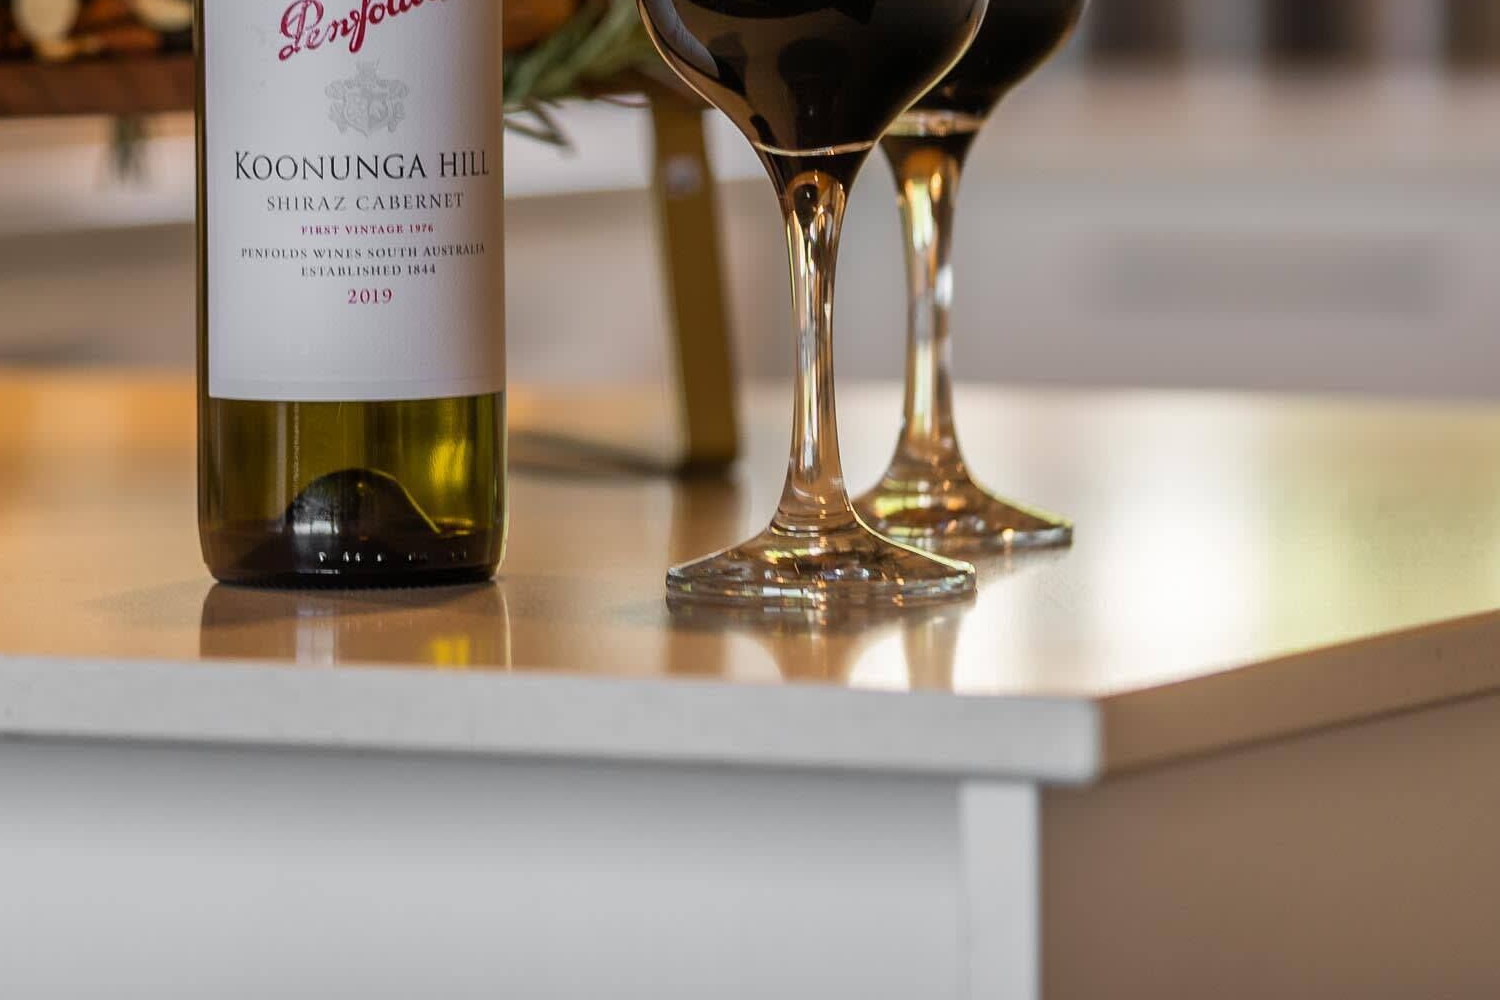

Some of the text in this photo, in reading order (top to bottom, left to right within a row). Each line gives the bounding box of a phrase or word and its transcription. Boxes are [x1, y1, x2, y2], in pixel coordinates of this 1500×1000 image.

[235, 150, 490, 181] KOONUNGA HILL
[266, 192, 465, 212] SHIRAZ CABERNET
[301, 223, 434, 236] FIRST VINTAGE 1976
[241, 242, 485, 259] PENFOLDS WINES SOUTH AUSTRALIA
[301, 263, 436, 277] ESTABLISHED 1844
[347, 288, 393, 305] 2019
